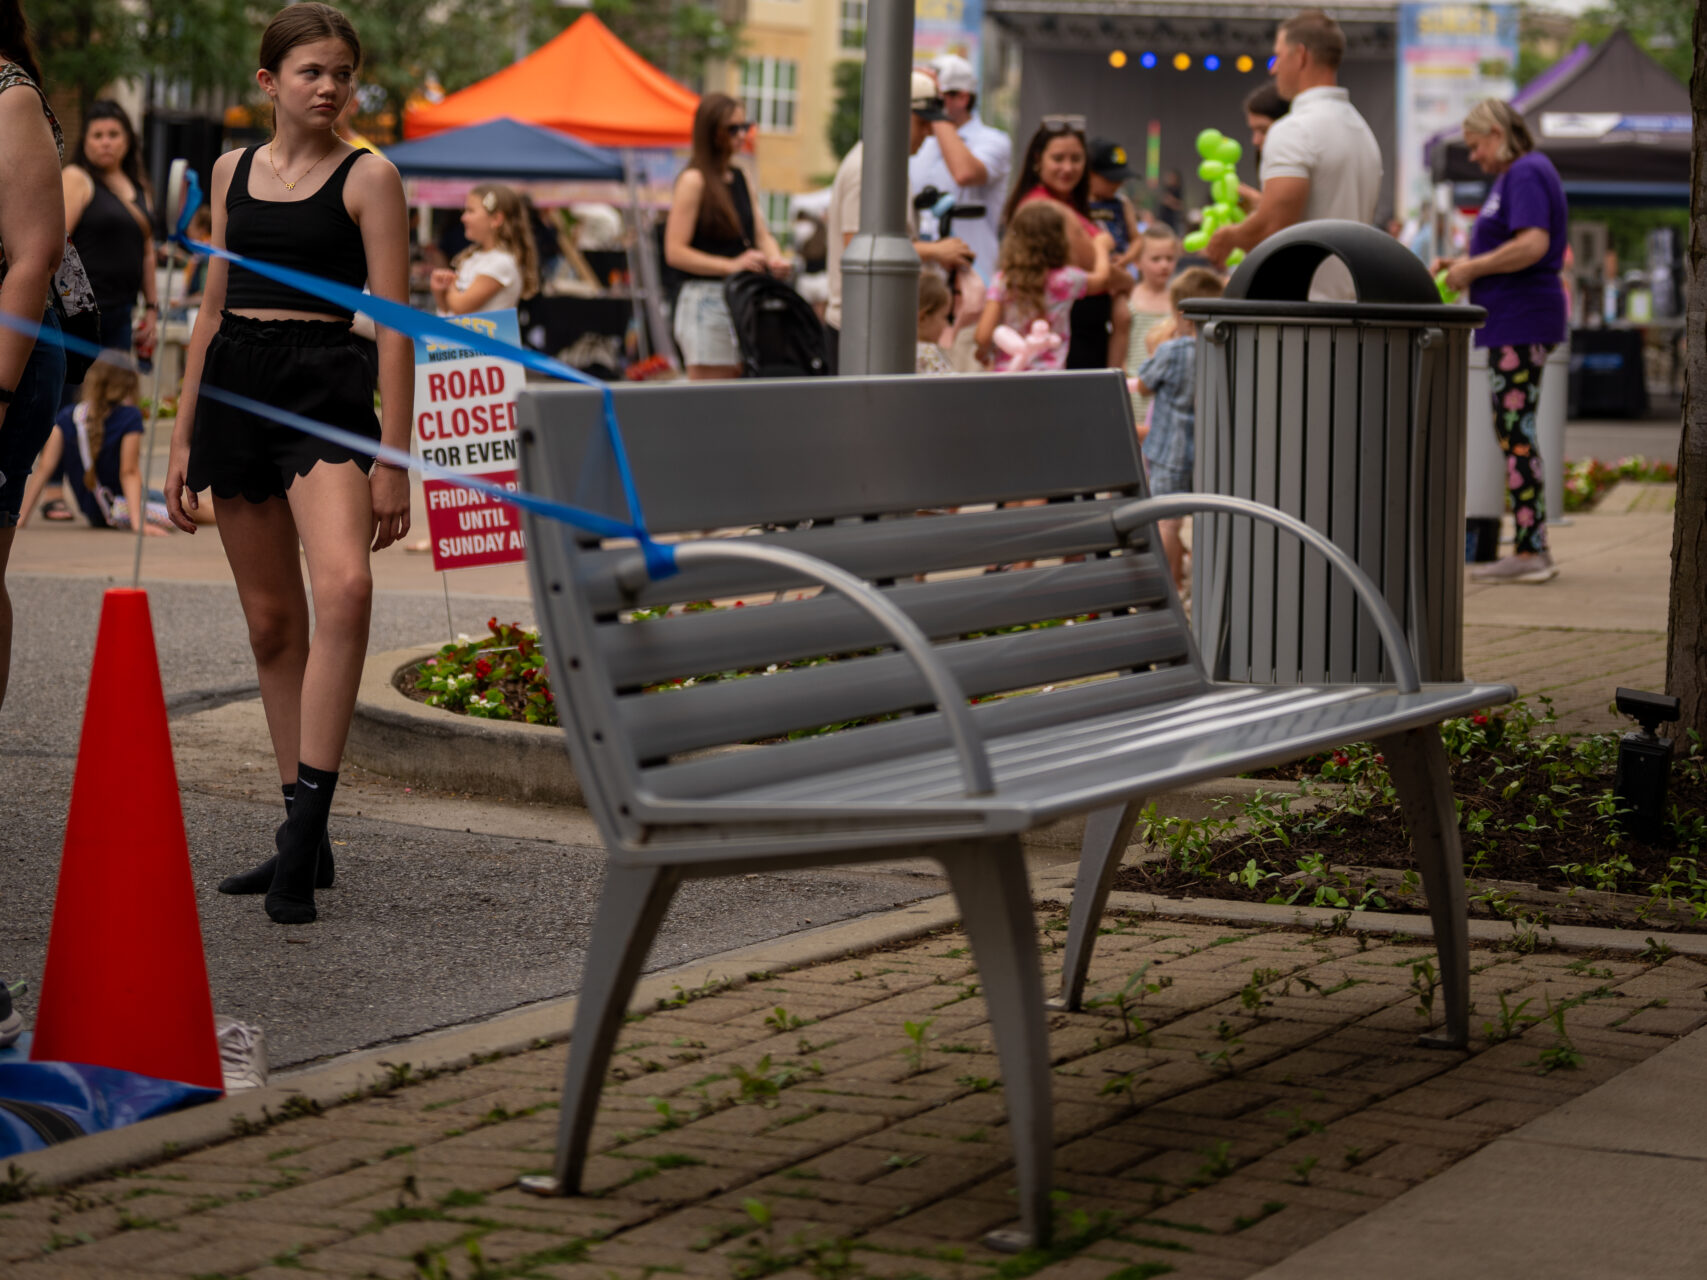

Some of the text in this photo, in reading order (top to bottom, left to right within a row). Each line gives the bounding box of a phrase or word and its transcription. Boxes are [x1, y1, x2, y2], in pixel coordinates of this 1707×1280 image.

[428, 347, 494, 362] MUSIC FEST
[428, 366, 505, 403] ROAD
[417, 401, 520, 442] CLOSED
[422, 438, 519, 470] FOR EVEN
[429, 487, 487, 510] FRIDAY
[505, 481, 522, 503] P
[458, 507, 510, 531] UNTIL
[438, 531, 506, 558] SUNDAY
